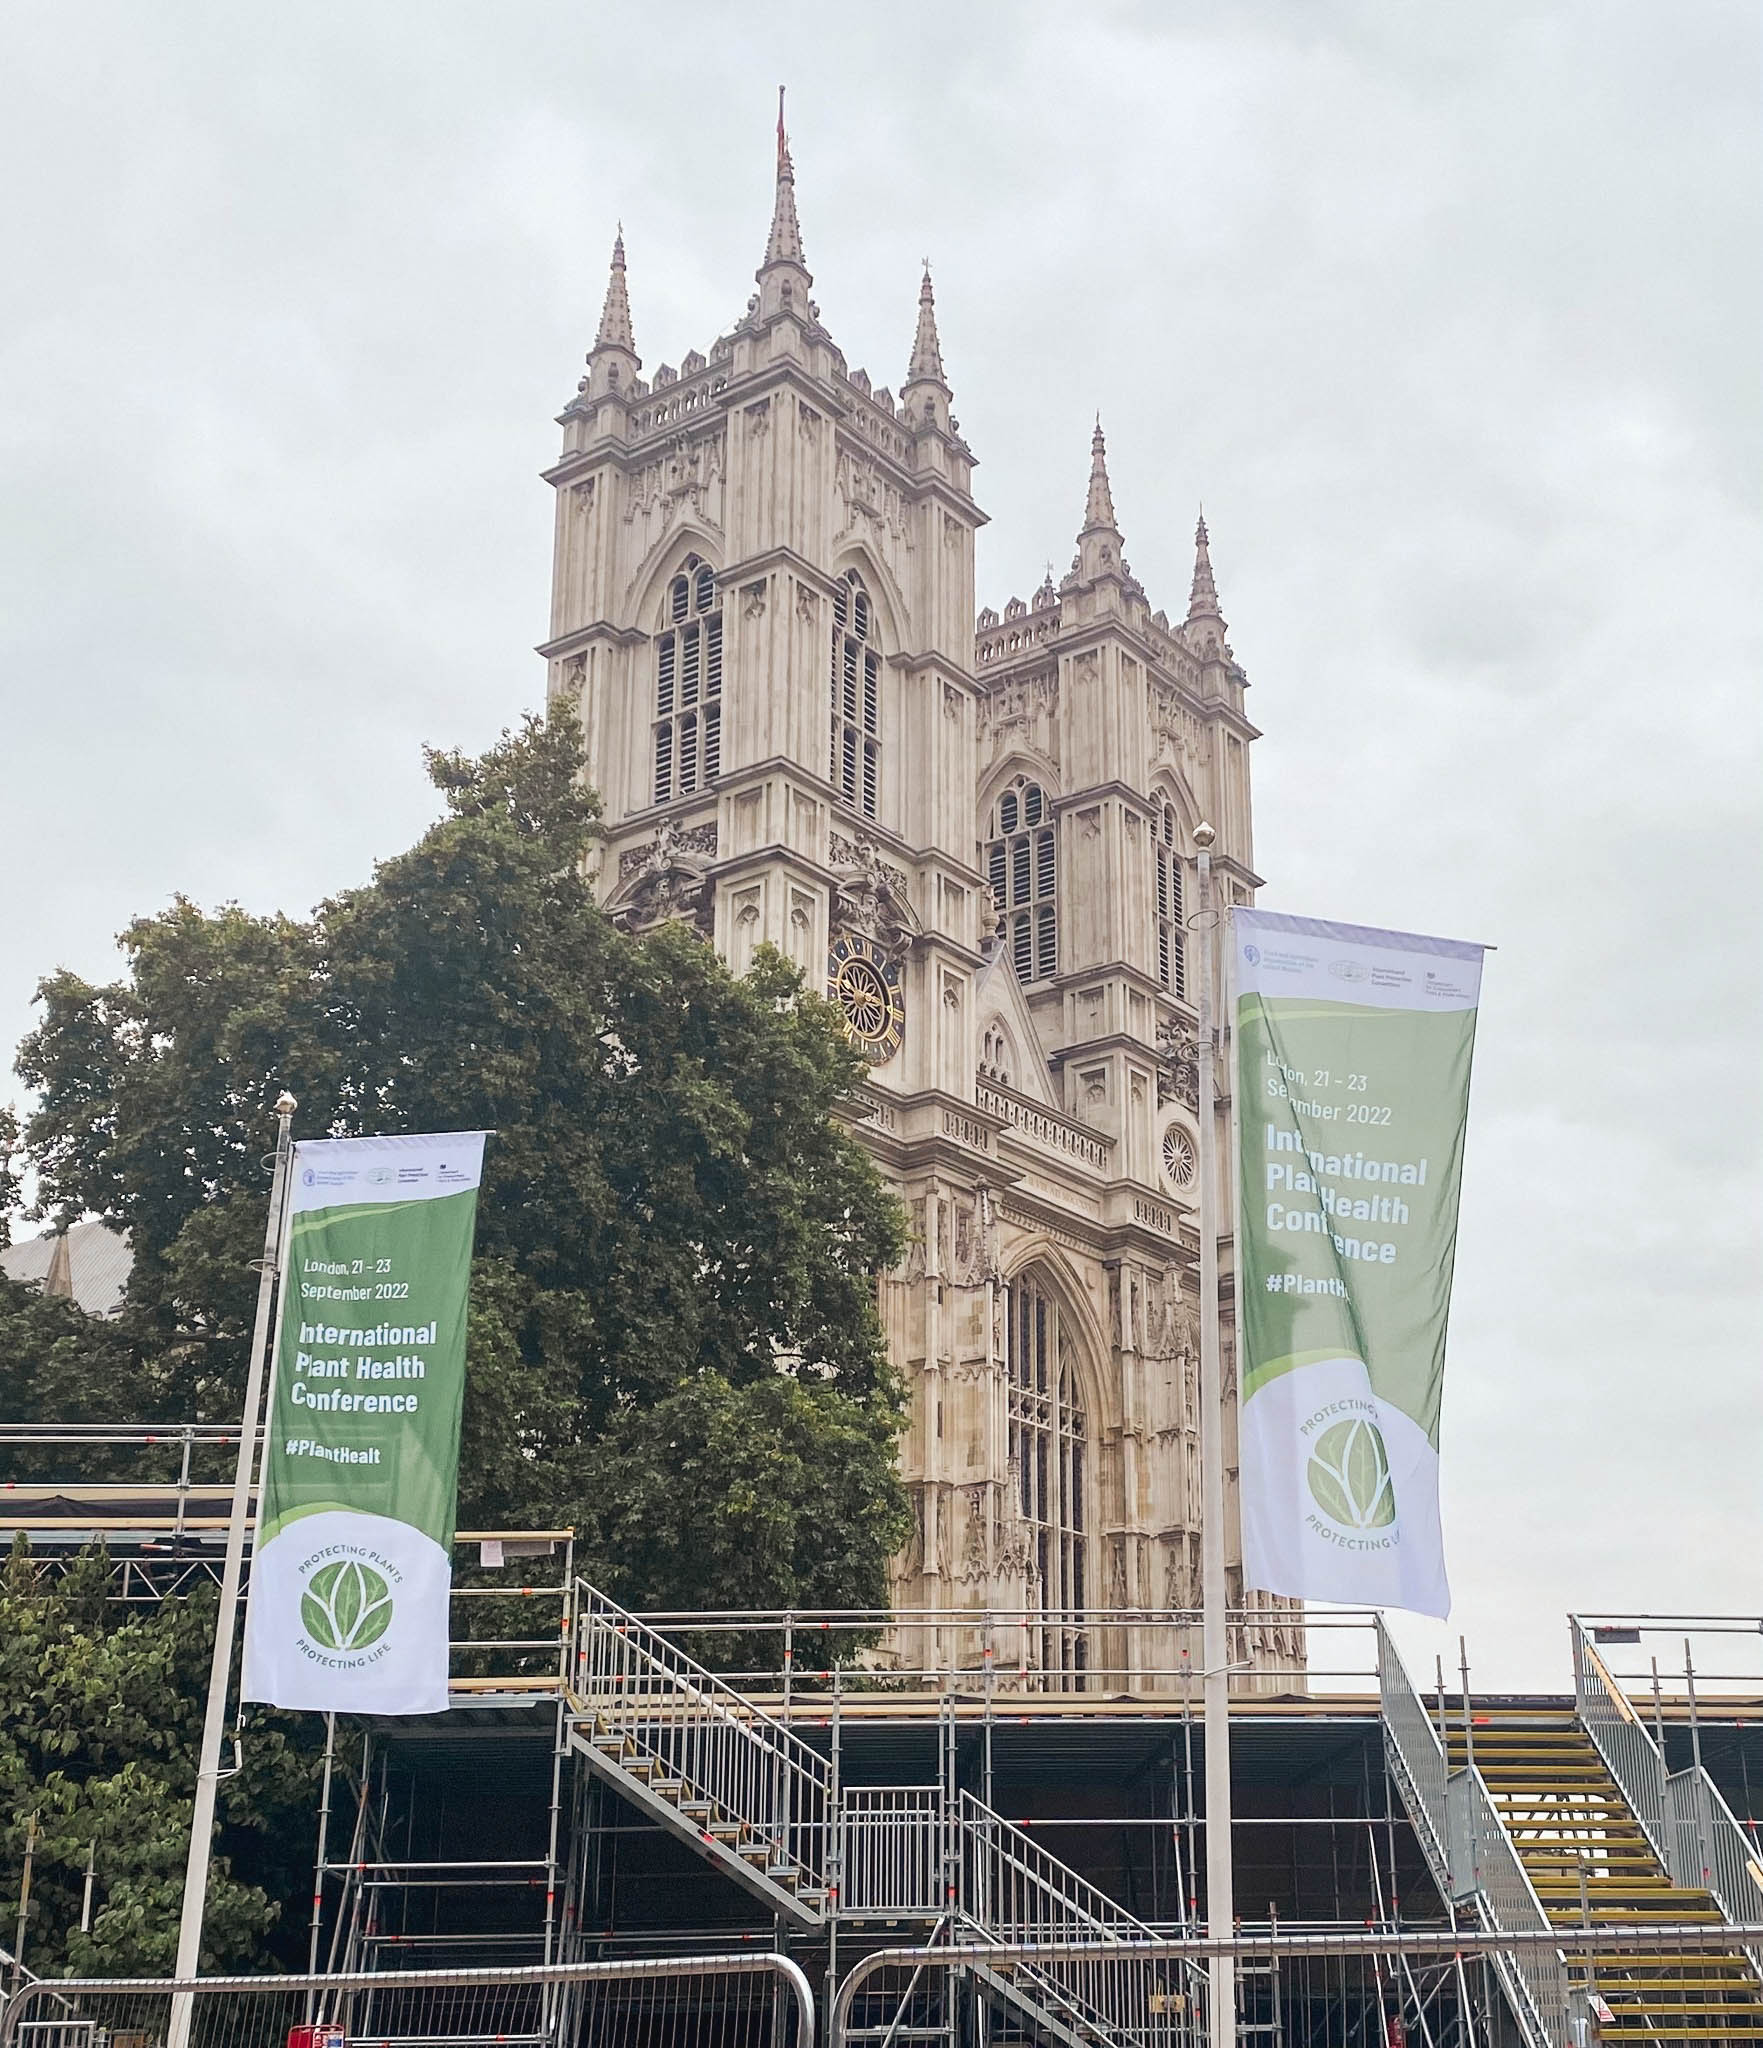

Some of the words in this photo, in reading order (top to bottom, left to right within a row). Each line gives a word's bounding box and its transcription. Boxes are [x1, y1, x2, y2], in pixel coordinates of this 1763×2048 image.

[1314, 1070, 1329, 1087] 21
[1347, 1074, 1368, 1091] 23
[1347, 1104, 1392, 1126] 2022
[1266, 1123, 1428, 1186] Intnational
[1320, 1186, 1410, 1225] Health
[1266, 1203, 1397, 1264] Confence
[304, 1259, 349, 1275] London,
[351, 1260, 363, 1274] 21
[376, 1259, 392, 1273] 23
[301, 1282, 372, 1301] September
[375, 1283, 409, 1299] 2022
[299, 1321, 437, 1346] International
[295, 1351, 350, 1378] Plant
[355, 1355, 425, 1380] Health
[291, 1381, 419, 1413] Conference
[1305, 1514, 1391, 1551] PROTECTING
[298, 1544, 367, 1574] PROTECTING
[368, 1551, 403, 1584] PLANTS
[296, 1639, 365, 1669] PROTECTING
[368, 1643, 391, 1662] LIFE
